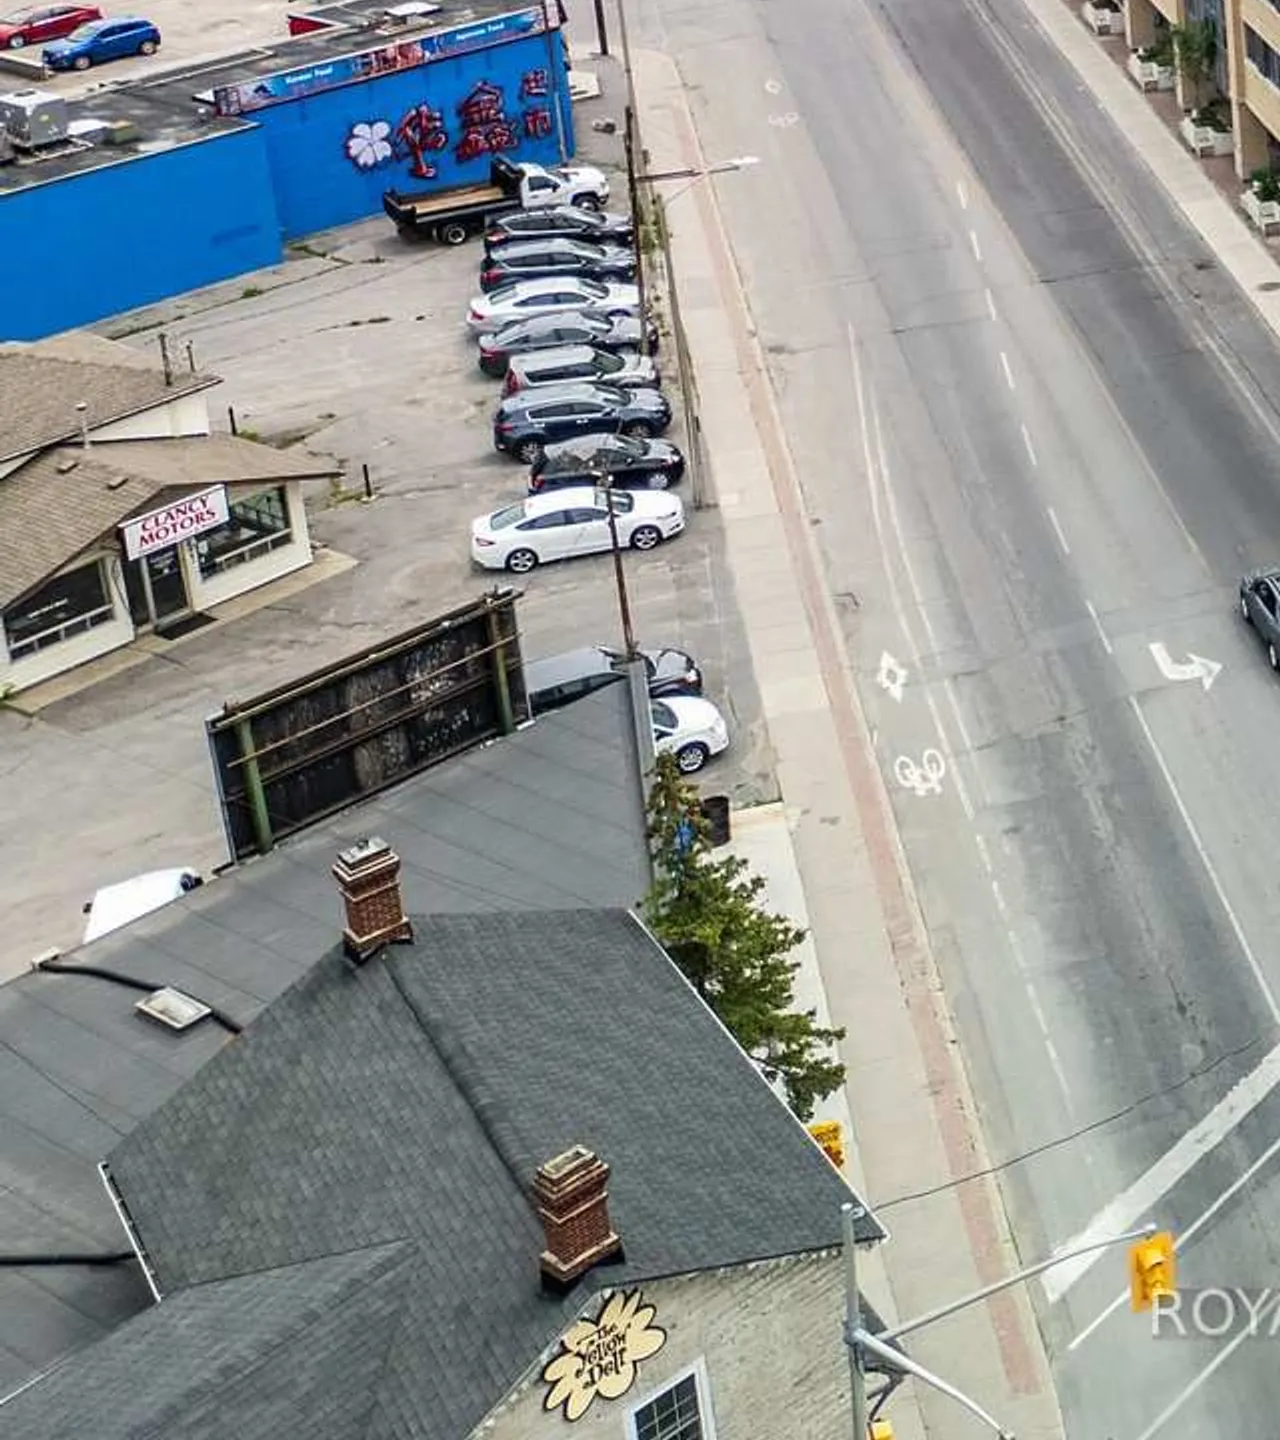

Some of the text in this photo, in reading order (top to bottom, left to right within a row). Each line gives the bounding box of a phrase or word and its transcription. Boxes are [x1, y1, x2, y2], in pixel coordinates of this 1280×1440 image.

[139, 509, 216, 548] MOTORS
[141, 495, 209, 532] CLANCY
[574, 1322, 632, 1380] Yellow
[582, 1347, 627, 1390] Deli
